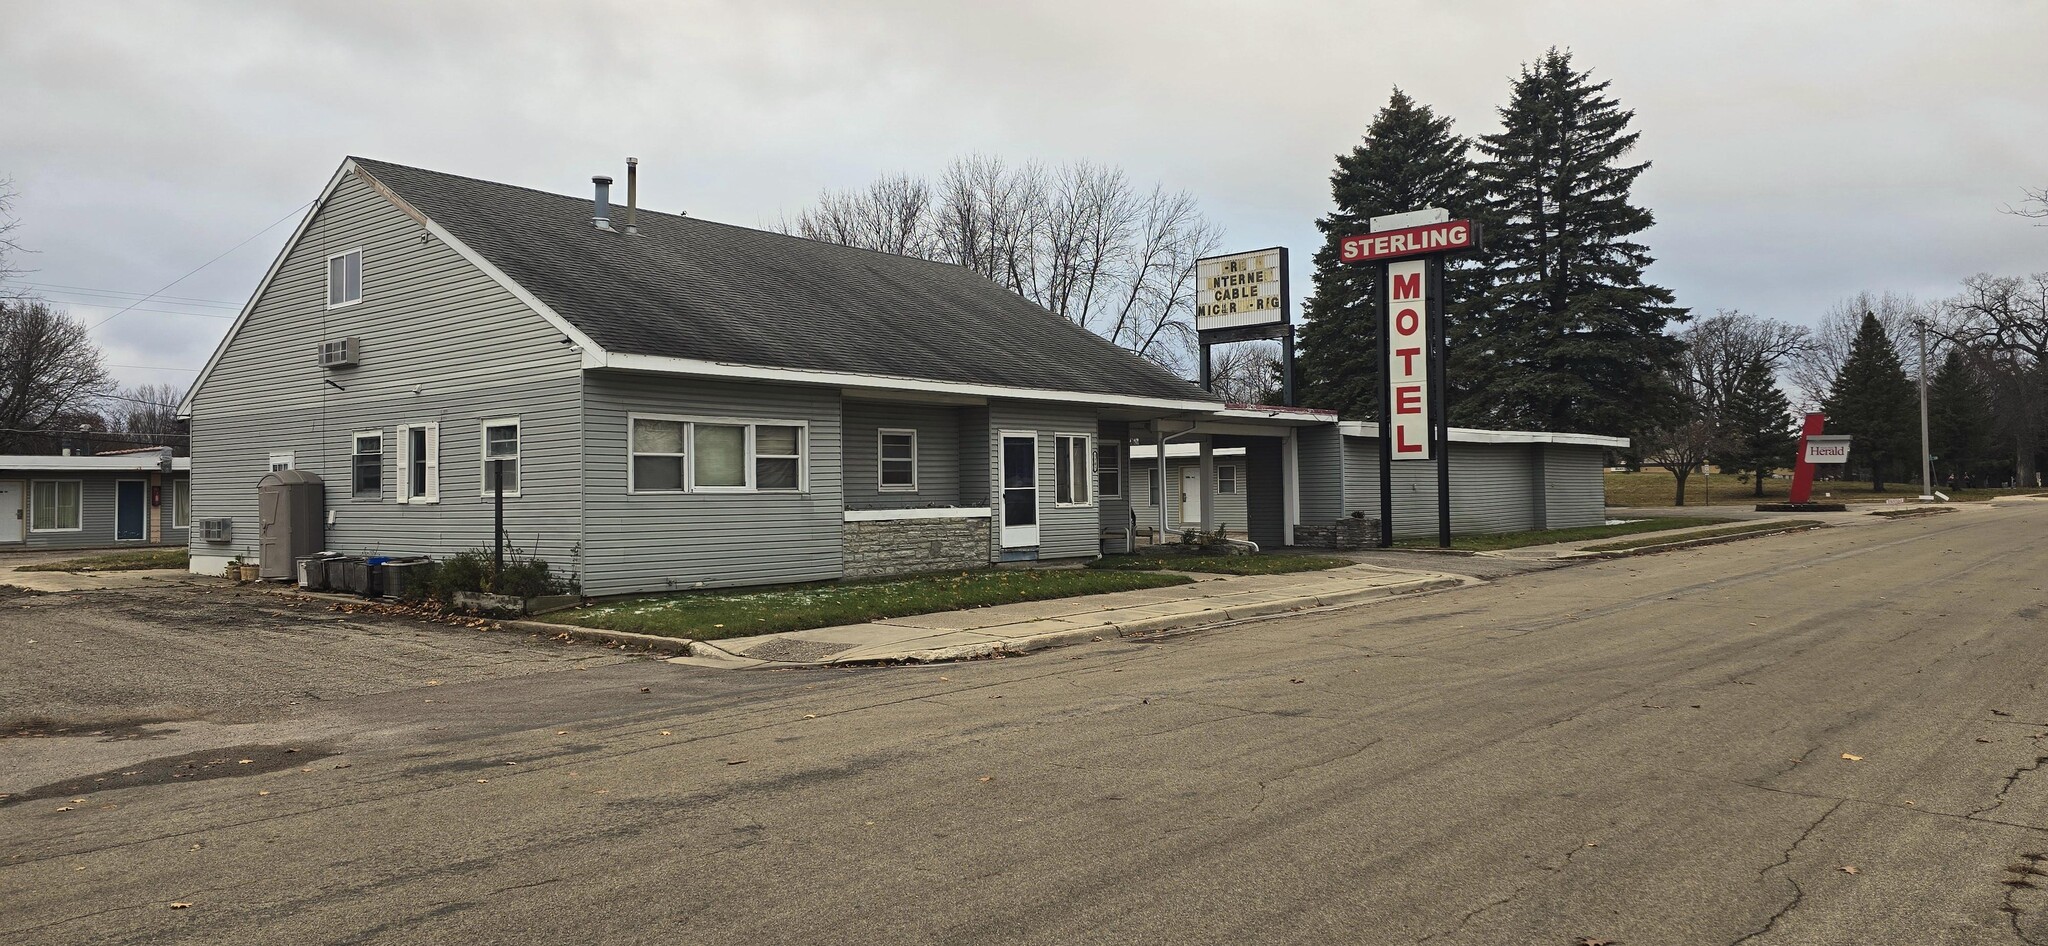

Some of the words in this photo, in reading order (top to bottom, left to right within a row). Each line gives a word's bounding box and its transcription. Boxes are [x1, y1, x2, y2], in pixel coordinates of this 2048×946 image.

[1343, 226, 1467, 259] STERLING
[1209, 271, 1271, 289] NTERNE
[1214, 286, 1258, 301] CABLE
[1393, 272, 1422, 453] MOTEL
[1810, 446, 1845, 456] Herald
